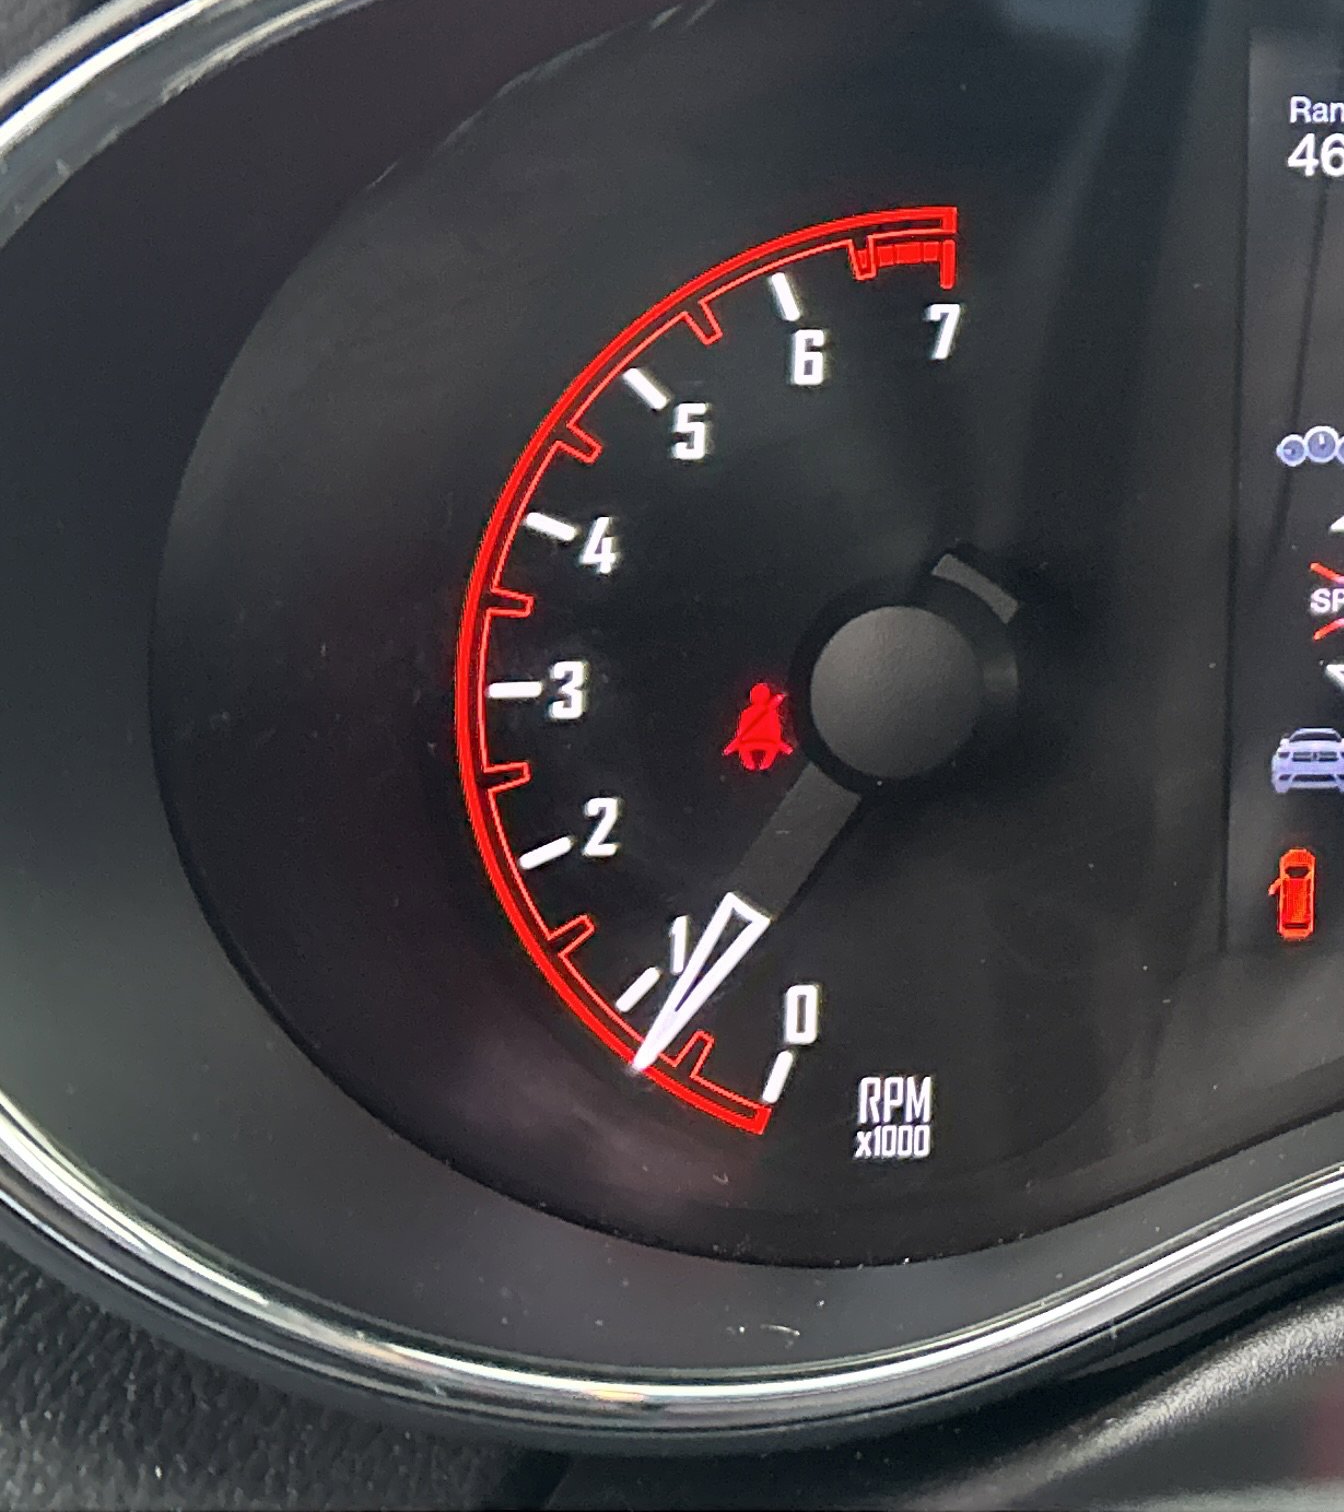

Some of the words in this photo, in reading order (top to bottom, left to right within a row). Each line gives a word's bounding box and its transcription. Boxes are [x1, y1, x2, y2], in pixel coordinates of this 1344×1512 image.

[791, 328, 826, 387] 6
[926, 302, 962, 361] 7
[672, 402, 709, 461] 5
[579, 516, 619, 575] 4
[549, 660, 587, 719] 3
[583, 797, 621, 857] 2
[669, 915, 690, 975] 1
[783, 985, 820, 1044] 0
[857, 1076, 933, 1124] RPM
[855, 1125, 931, 1158] x1000
